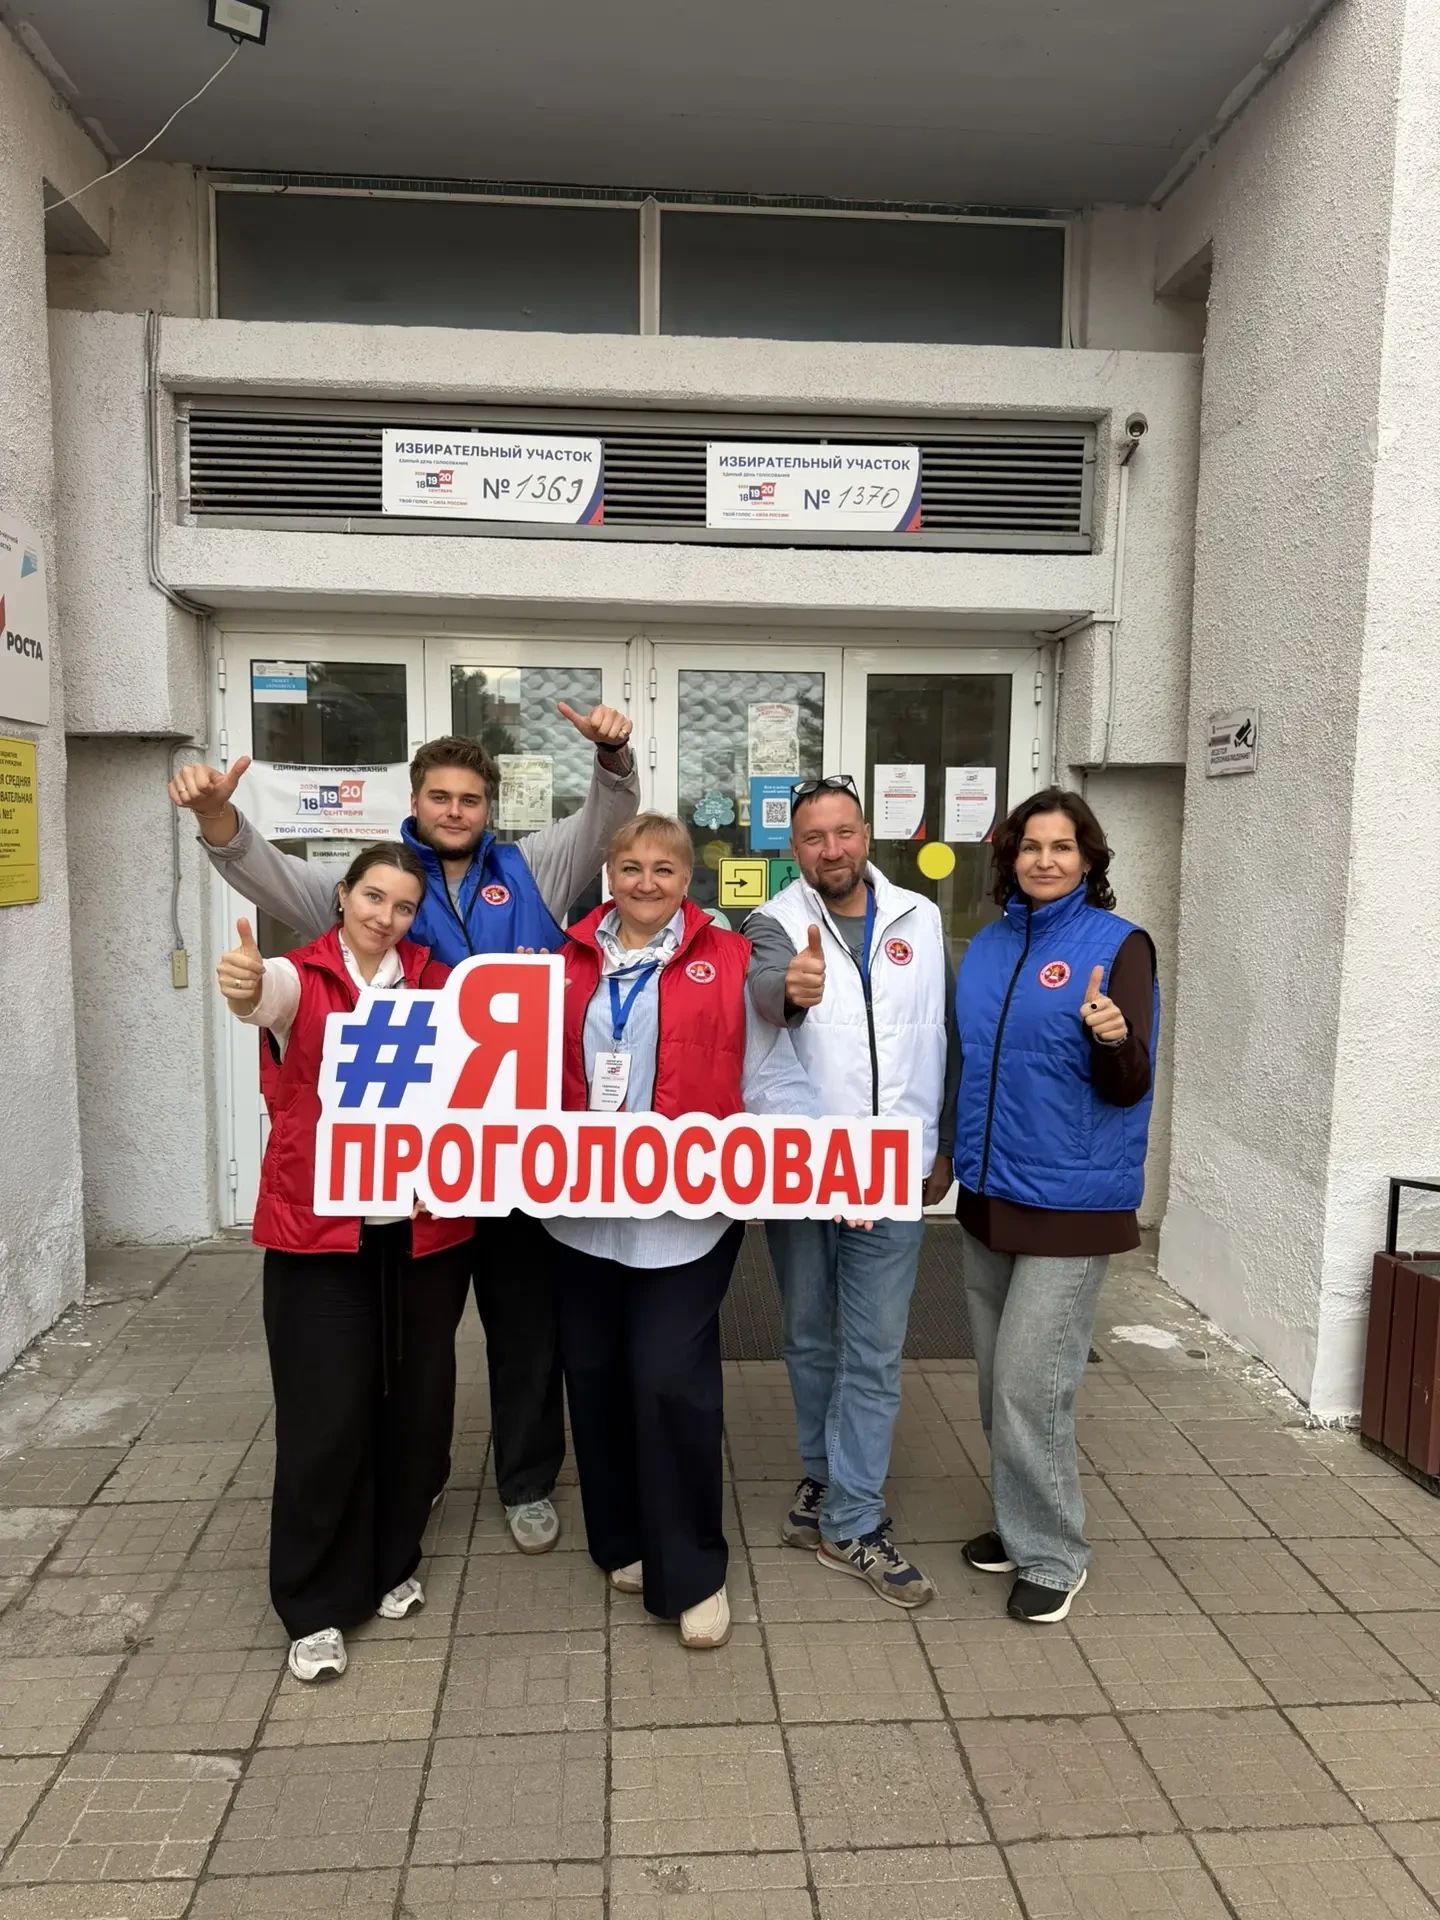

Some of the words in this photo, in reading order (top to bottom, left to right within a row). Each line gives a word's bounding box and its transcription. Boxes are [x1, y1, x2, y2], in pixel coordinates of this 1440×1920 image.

[395, 442, 522, 460] ИЗБИРАТЕЛЬНЫЙ
[526, 448, 592, 462] УЧАСТОК
[719, 455, 842, 469] ИЗБИРАТЕЛЬНЫЙ
[847, 458, 910, 471] УЧАСТОК
[415, 480, 426, 489] 18
[427, 476, 438, 485] 19
[439, 473, 452, 482] 20
[483, 478, 510, 500] №
[515, 474, 584, 503] 1369
[739, 493, 749, 502] 18
[750, 489, 760, 498] 19
[761, 485, 774, 494] 20
[804, 489, 831, 510] №
[838, 485, 900, 509] 1370
[7, 631, 43, 661] РОСТА
[5, 774, 31, 788] СРЕДНЯЯ
[302, 798, 319, 810] 18
[321, 791, 338, 804] 19
[341, 786, 361, 798] 20
[275, 826, 297, 834] ТВОЙ
[328, 1122, 909, 1206] ПРОГОЛОСОВАЛ
[849, 1546, 877, 1574] N
